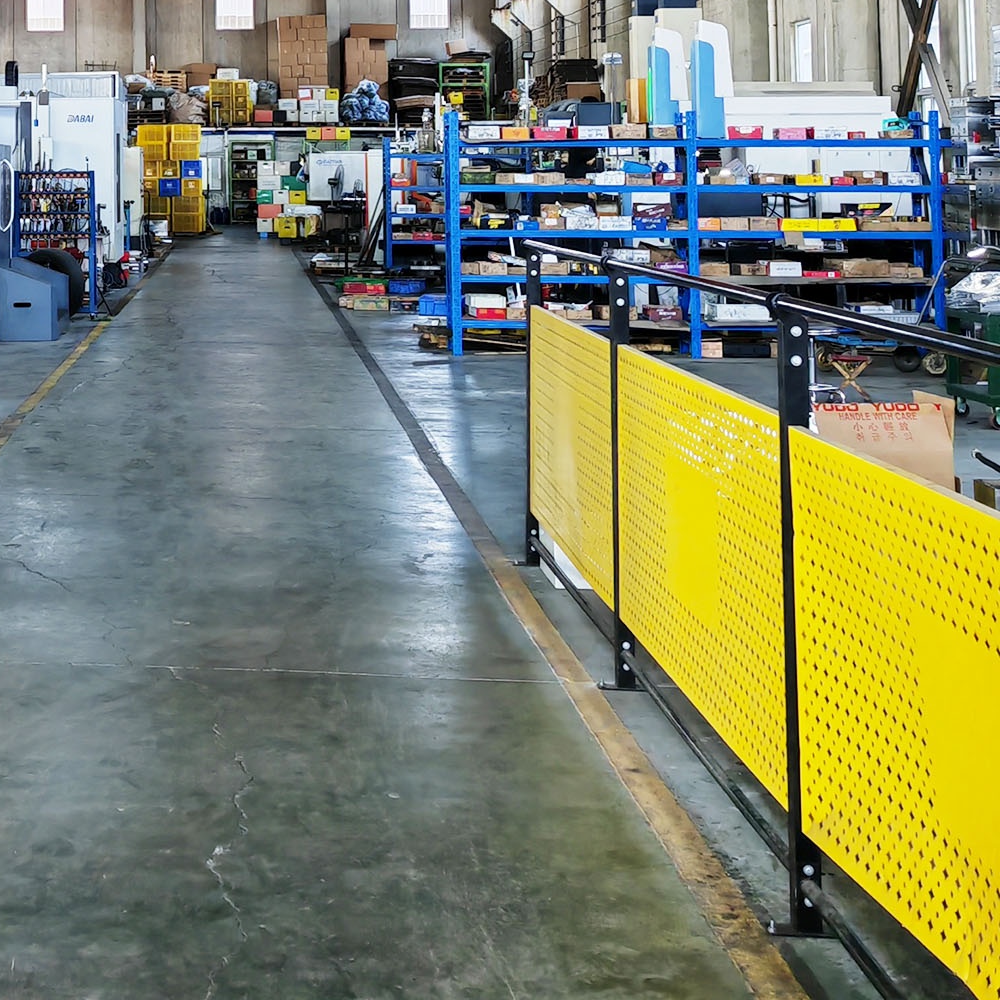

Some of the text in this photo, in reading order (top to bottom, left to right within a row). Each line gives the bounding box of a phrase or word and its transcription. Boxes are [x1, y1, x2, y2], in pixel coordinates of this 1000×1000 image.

[67, 114, 94, 123] DABAI
[838, 412, 918, 421] HANDLE WITH CARE
